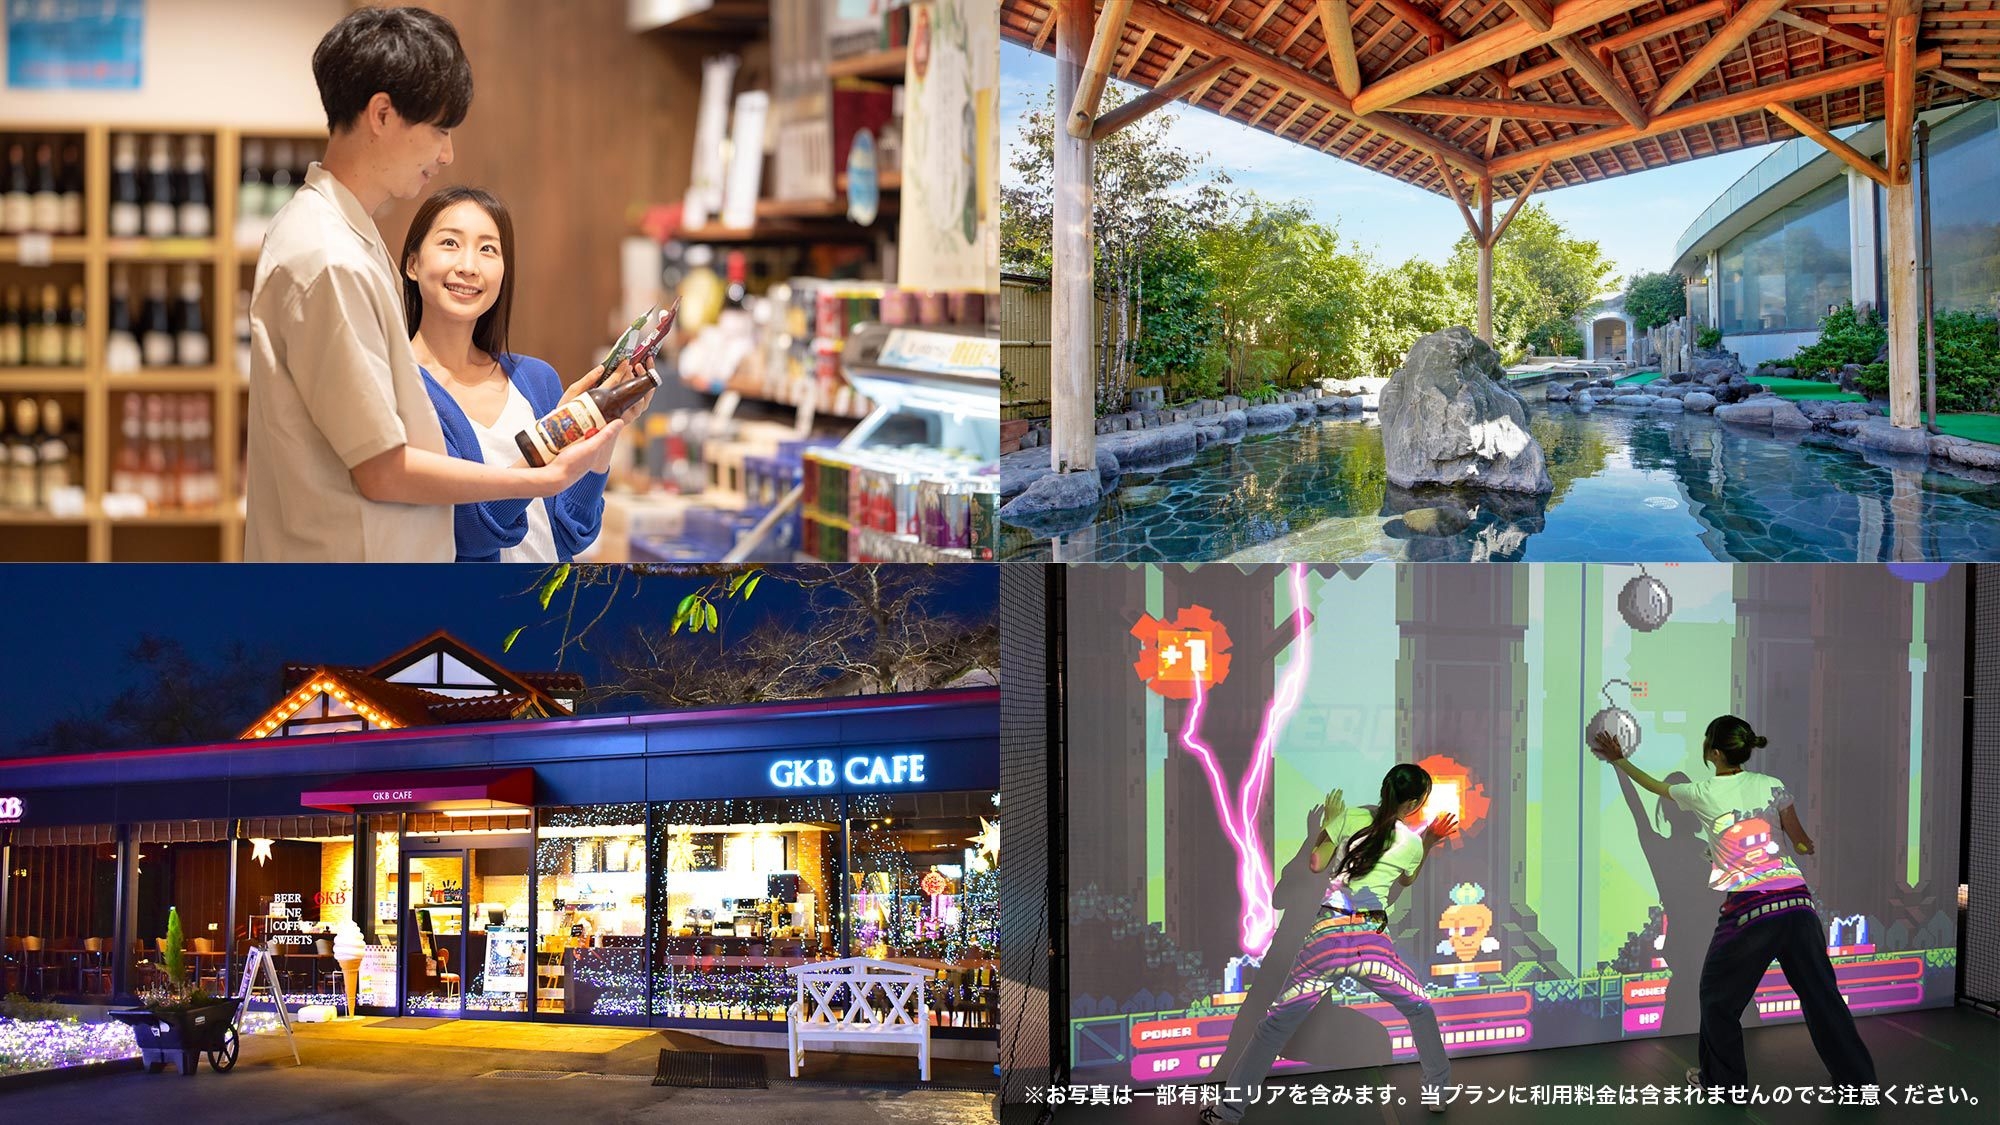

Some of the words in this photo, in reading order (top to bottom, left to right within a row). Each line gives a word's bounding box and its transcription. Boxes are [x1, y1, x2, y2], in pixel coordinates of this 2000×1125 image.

[1160, 639, 1206, 672] +1
[769, 759, 836, 787] GKB
[844, 754, 926, 785] CAFE
[372, 791, 390, 801] GKB
[392, 791, 413, 800] CAFE
[274, 893, 302, 903] BEER
[272, 934, 313, 945] SWEETS
[1639, 1012, 1660, 1025] HP
[1141, 1027, 1192, 1041] POWER
[1153, 1058, 1180, 1073] HP
